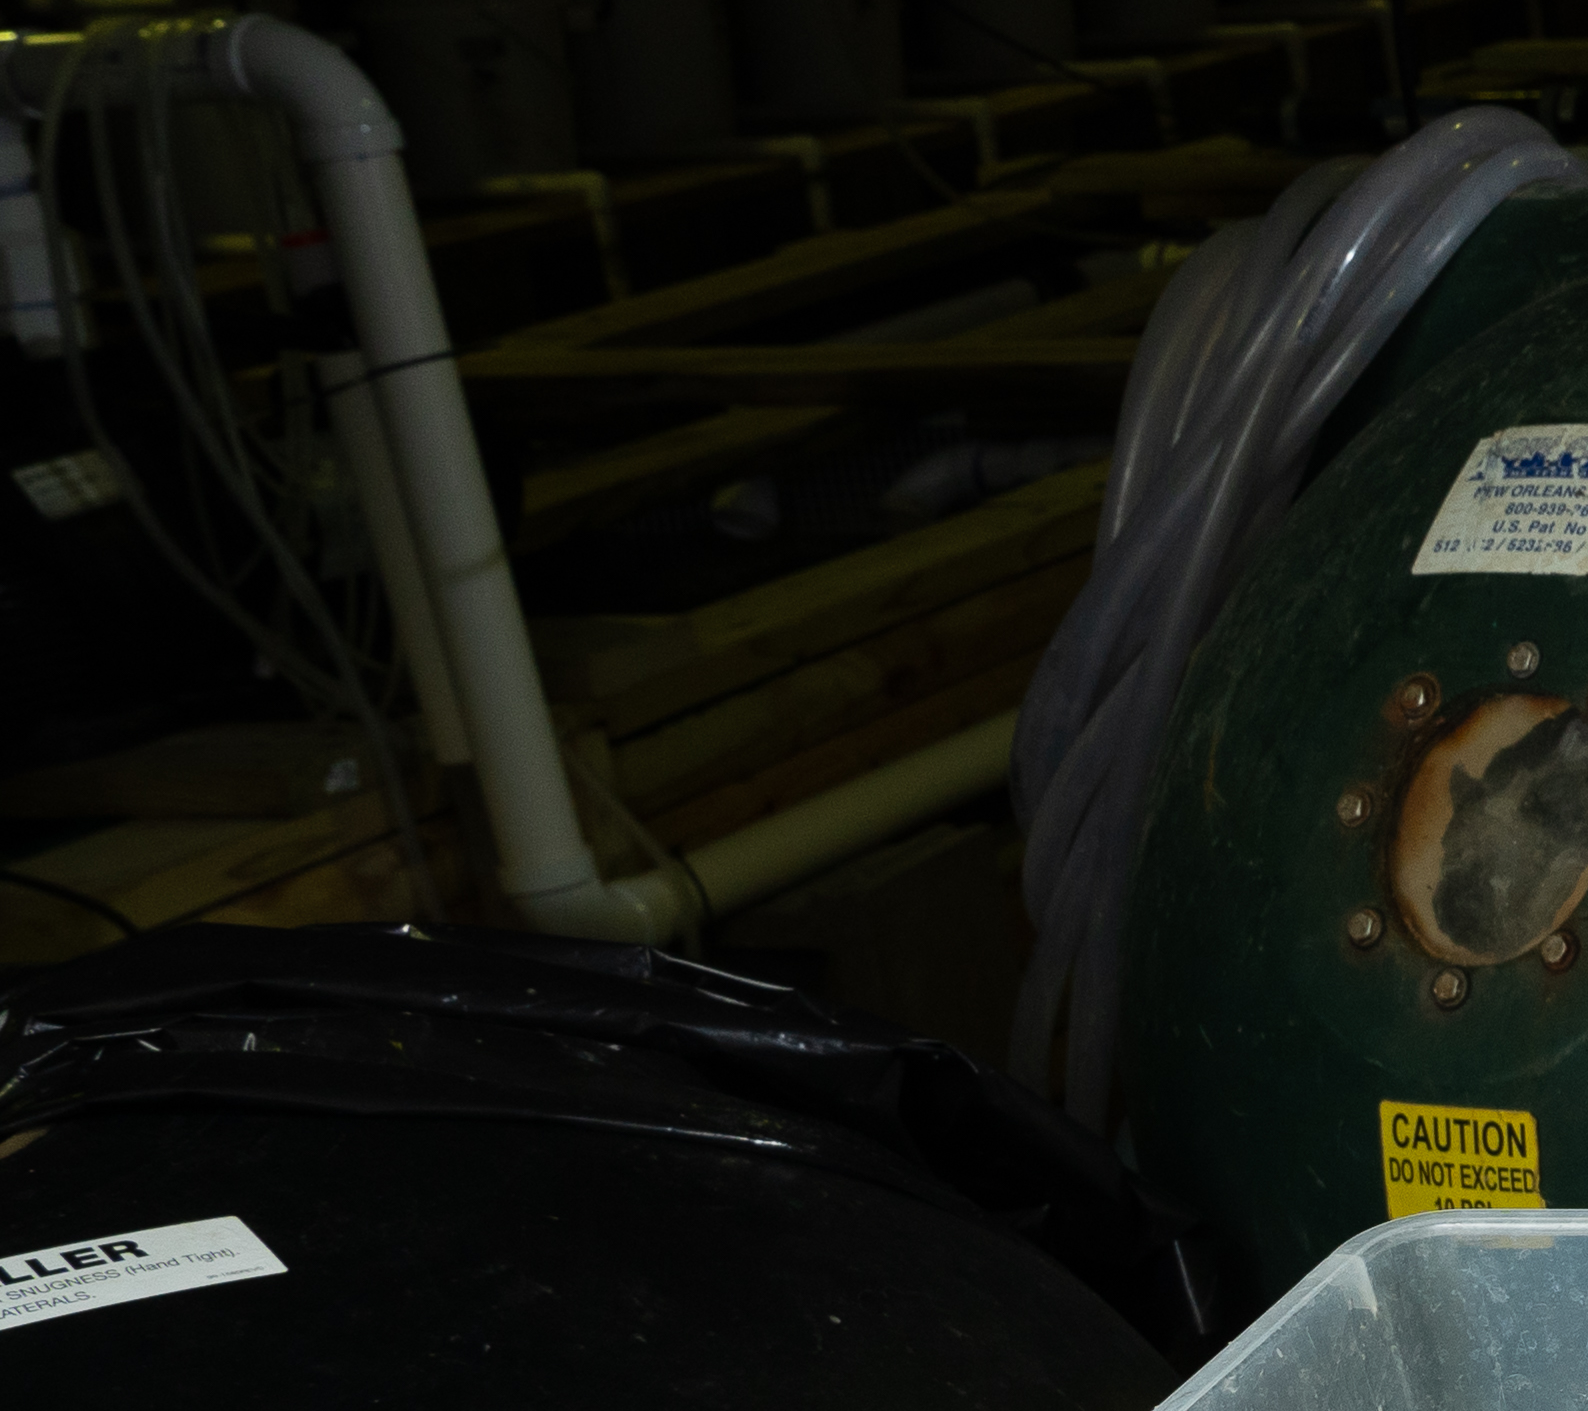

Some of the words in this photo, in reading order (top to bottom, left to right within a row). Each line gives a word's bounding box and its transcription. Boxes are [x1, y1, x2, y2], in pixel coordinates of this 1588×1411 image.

[1492, 520, 1522, 534] U.S.
[1392, 1113, 1527, 1157] CAUTION
[1389, 1157, 1414, 1183] DO
[1418, 1160, 1454, 1187] NOT
[1459, 1164, 1535, 1193] EXCEED
[6, 1268, 121, 1300] SNUGNESS
[124, 1258, 180, 1276] (Hand
[182, 1247, 241, 1265] Tight).
